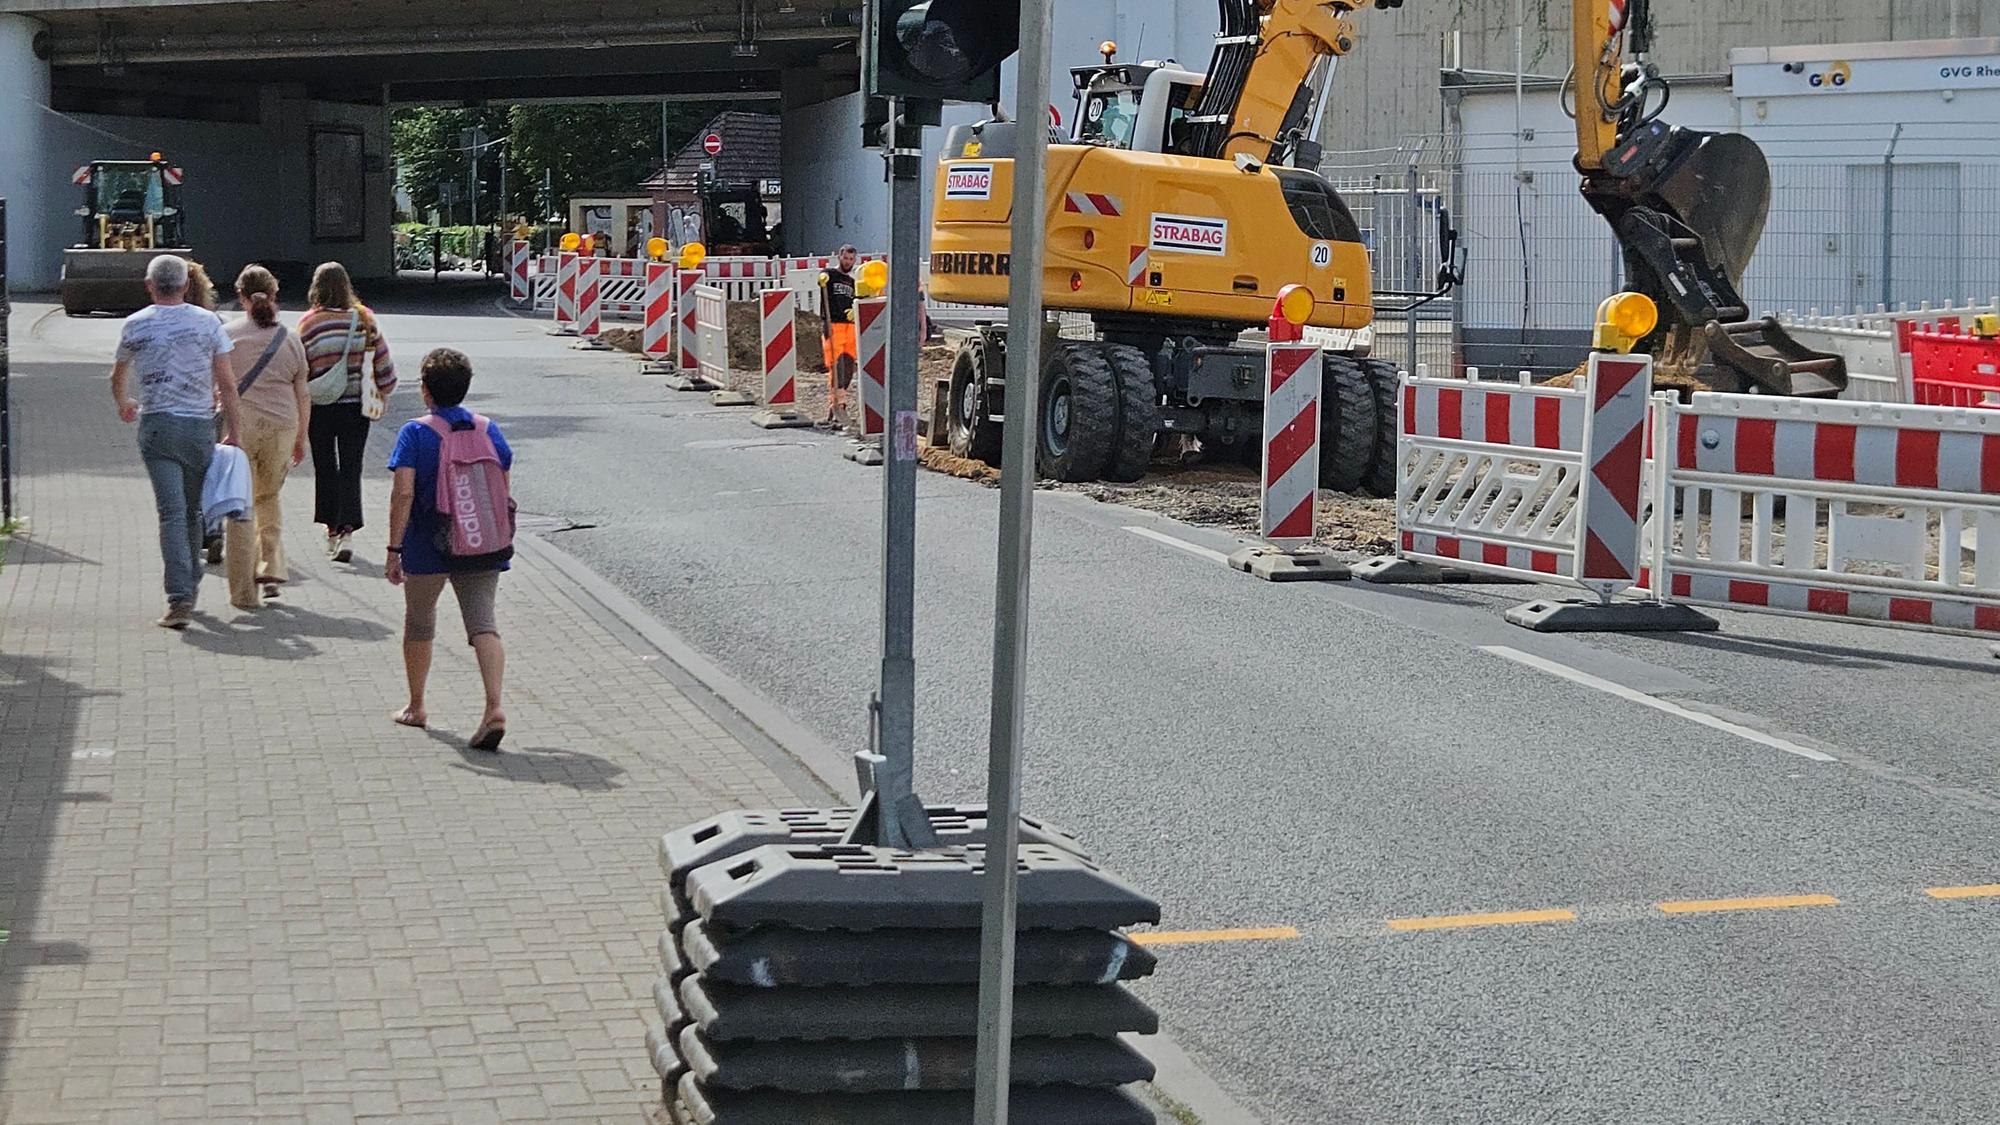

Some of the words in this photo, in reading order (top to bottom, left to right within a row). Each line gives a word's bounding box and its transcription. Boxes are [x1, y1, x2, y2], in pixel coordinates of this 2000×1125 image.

[1809, 73, 1845, 87] GVG
[1940, 67, 1972, 78] GVG
[1091, 102, 1100, 117] 20
[948, 174, 988, 189] STRABAG
[1153, 224, 1223, 245] STRABAG
[1314, 246, 1328, 263] 20
[455, 474, 483, 548] adidas
